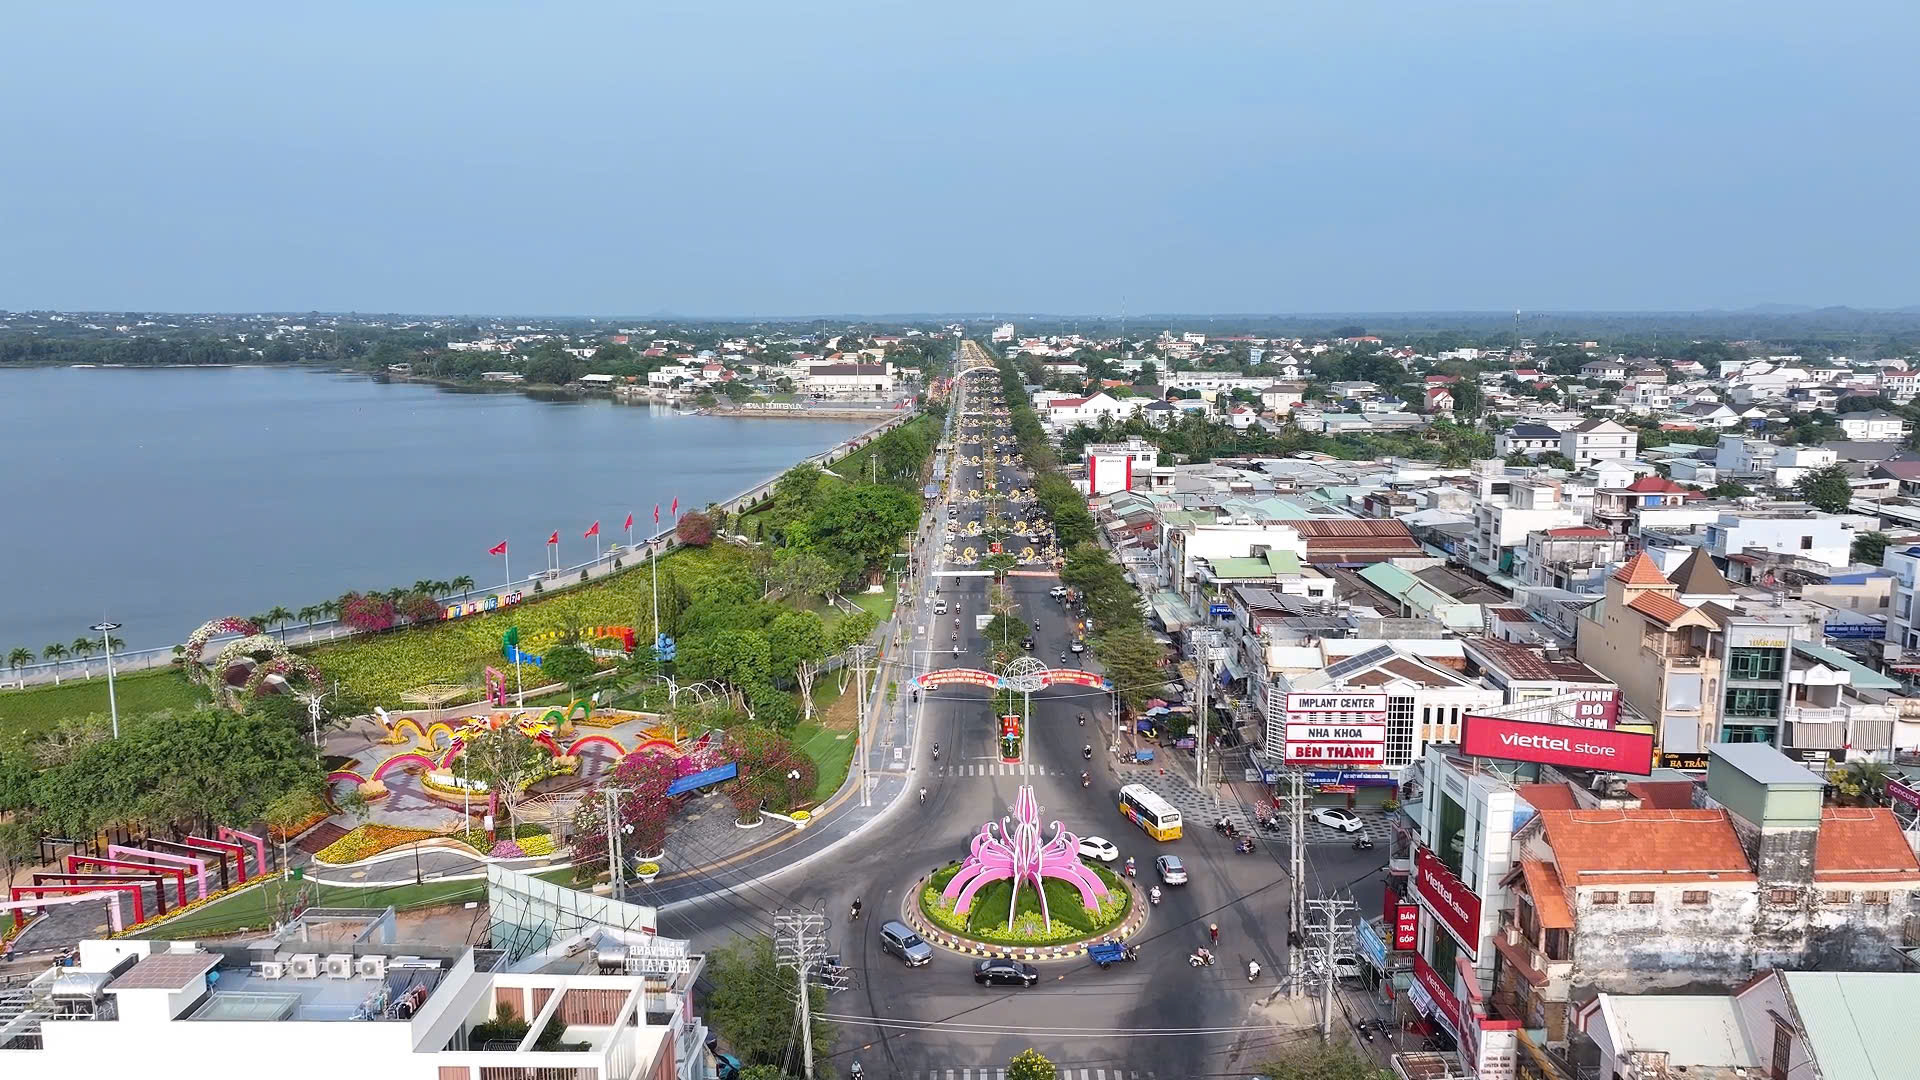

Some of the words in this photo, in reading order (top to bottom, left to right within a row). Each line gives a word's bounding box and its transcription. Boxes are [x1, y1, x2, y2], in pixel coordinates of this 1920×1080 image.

[1299, 698, 1338, 708] IMPLANT
[1340, 698, 1375, 708] CENTER
[1308, 728, 1330, 738] NHA
[1334, 728, 1363, 738] KHOA
[1500, 733, 1571, 752] viettel
[1575, 743, 1616, 756] store
[1425, 869, 1453, 907] viettel
[1452, 901, 1469, 923] store
[1400, 912, 1416, 920] BÁN
[1399, 935, 1415, 943] GÓP
